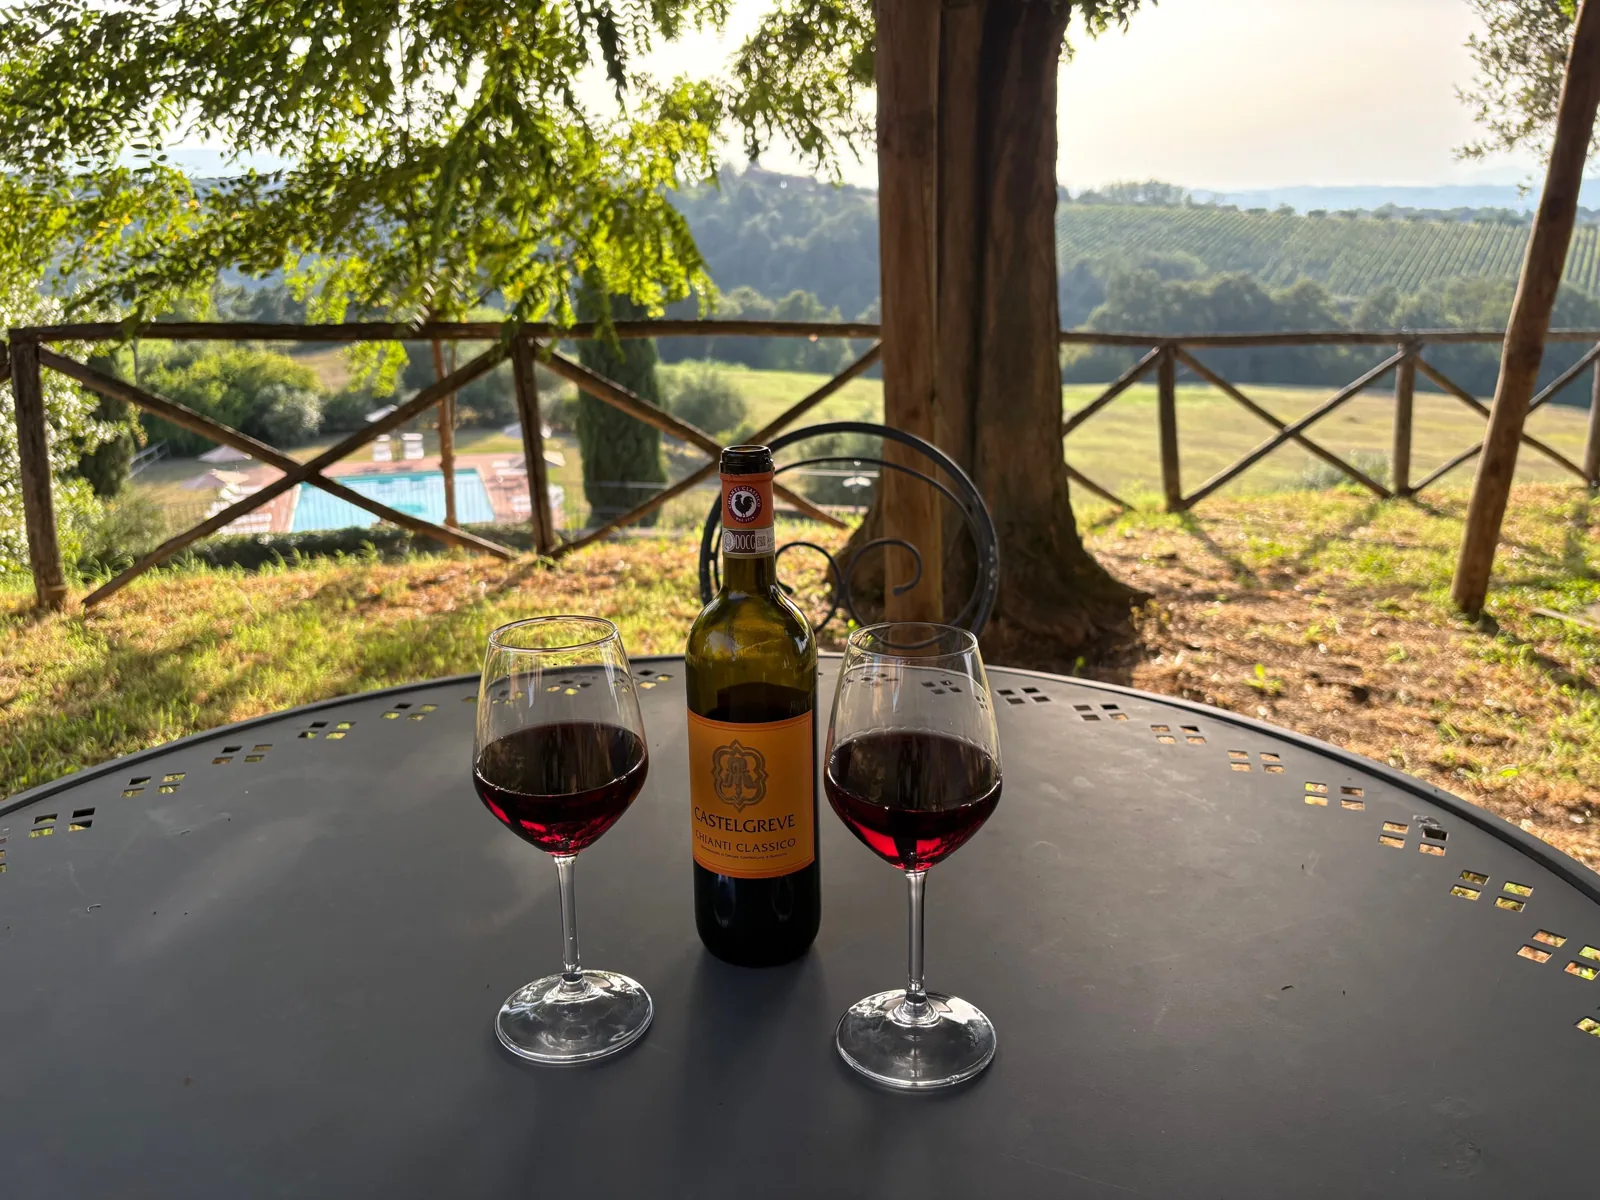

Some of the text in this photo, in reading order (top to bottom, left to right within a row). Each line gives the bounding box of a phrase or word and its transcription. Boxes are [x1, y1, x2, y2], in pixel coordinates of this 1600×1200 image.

[728, 486, 761, 509] CHIANTI CLASSICO
[735, 535, 755, 550] DOCG
[694, 806, 796, 833] CASTELGREVE
[695, 829, 731, 851] CHIANTI
[736, 837, 796, 853] CLASSICO
